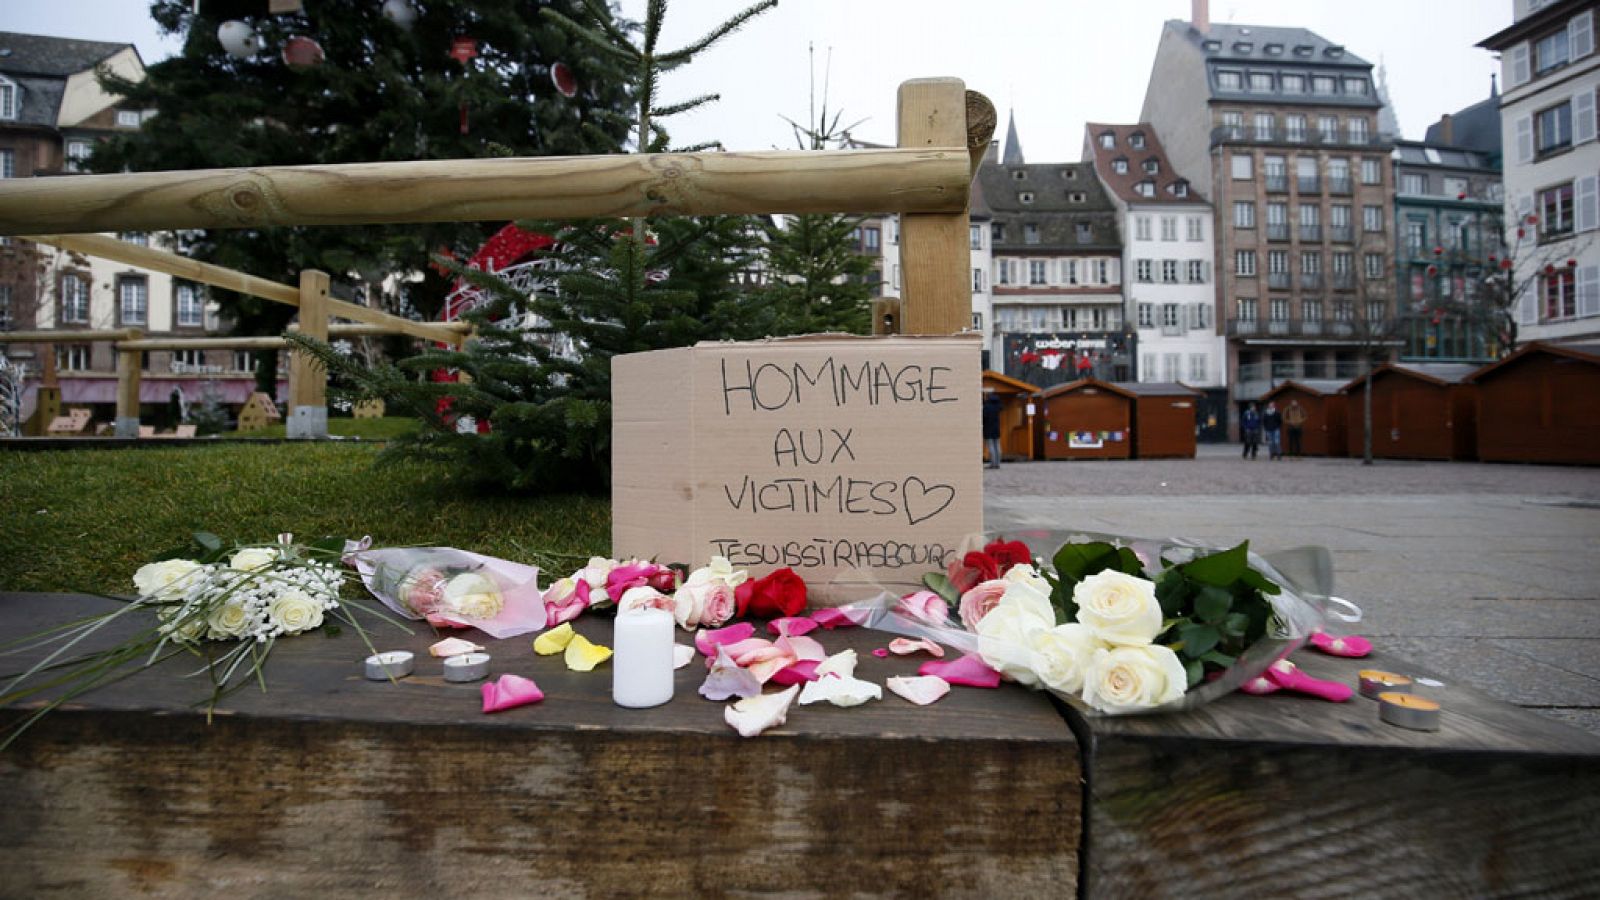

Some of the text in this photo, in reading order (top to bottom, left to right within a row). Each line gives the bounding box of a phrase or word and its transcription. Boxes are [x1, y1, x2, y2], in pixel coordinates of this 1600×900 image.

[721, 357, 958, 415] HOMMAGE
[774, 427, 855, 466] AUX
[724, 475, 897, 514] VICTIMES
